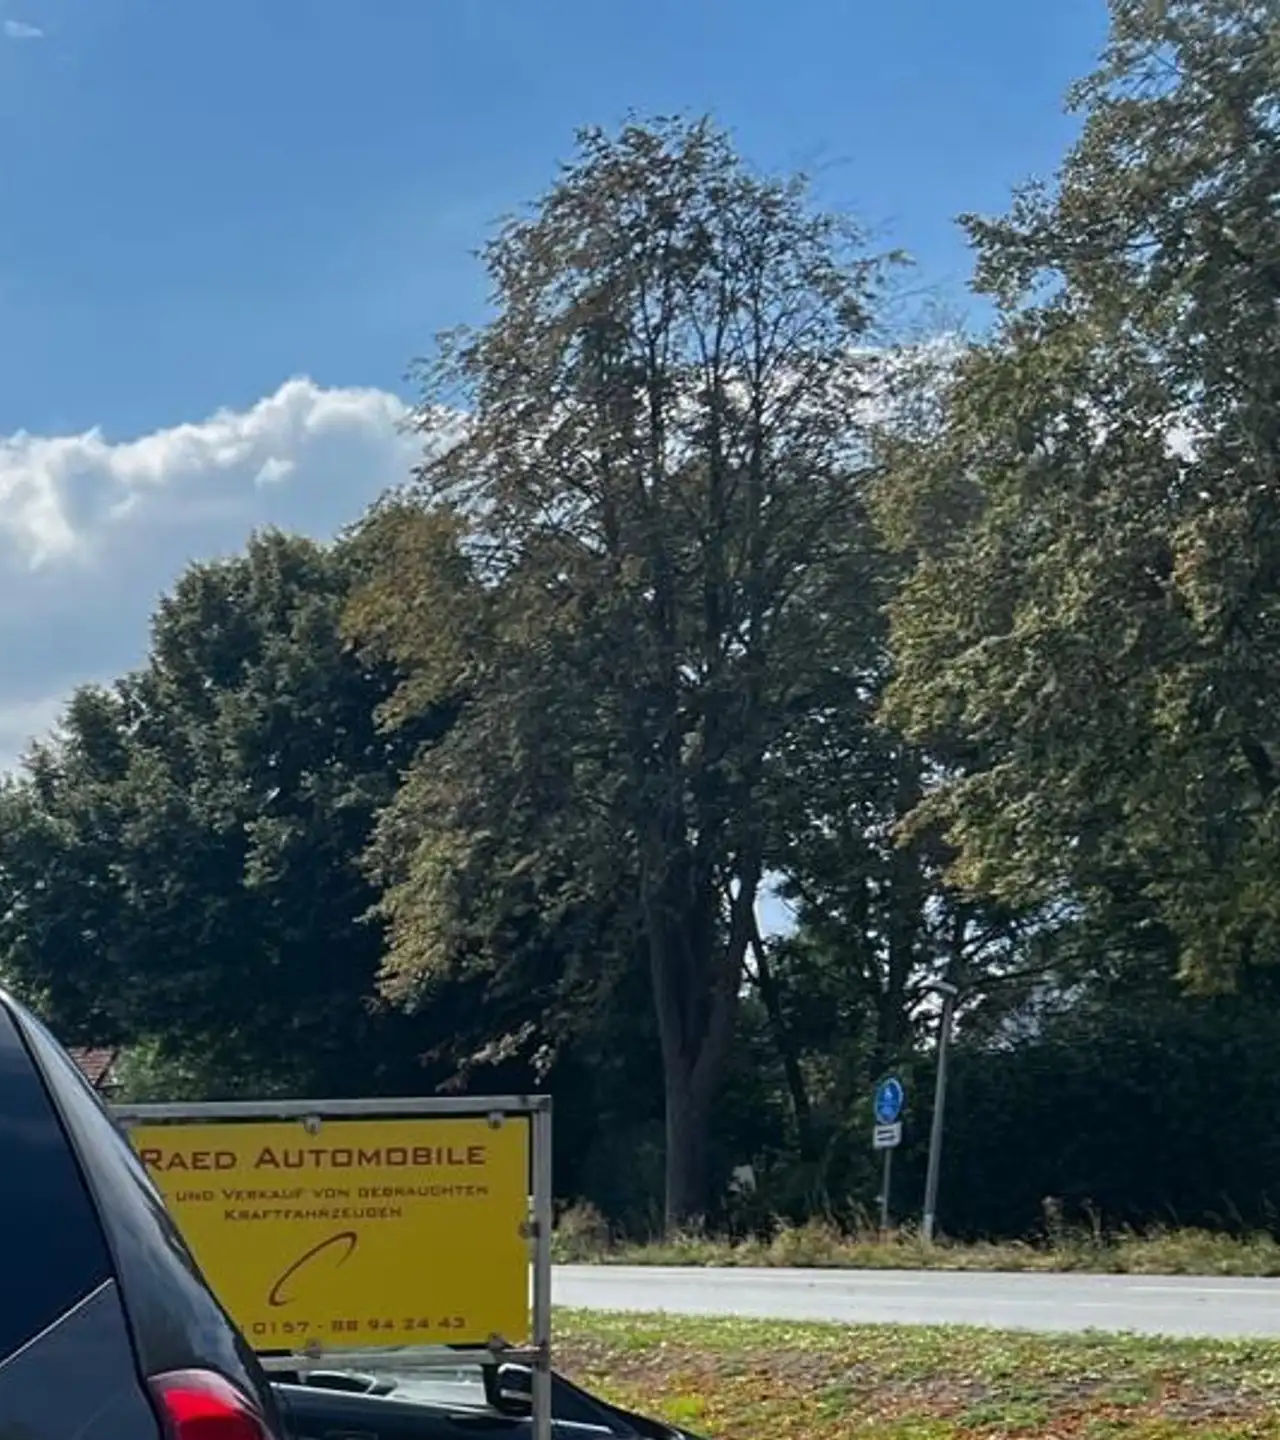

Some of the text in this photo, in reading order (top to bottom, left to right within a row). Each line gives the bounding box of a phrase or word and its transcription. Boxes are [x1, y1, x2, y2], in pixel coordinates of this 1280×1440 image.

[141, 1146, 486, 1171] RAED AUTOMOBILE
[176, 1190, 214, 1202] UND
[222, 1188, 303, 1201] VERKAUF
[313, 1186, 350, 1199] VON
